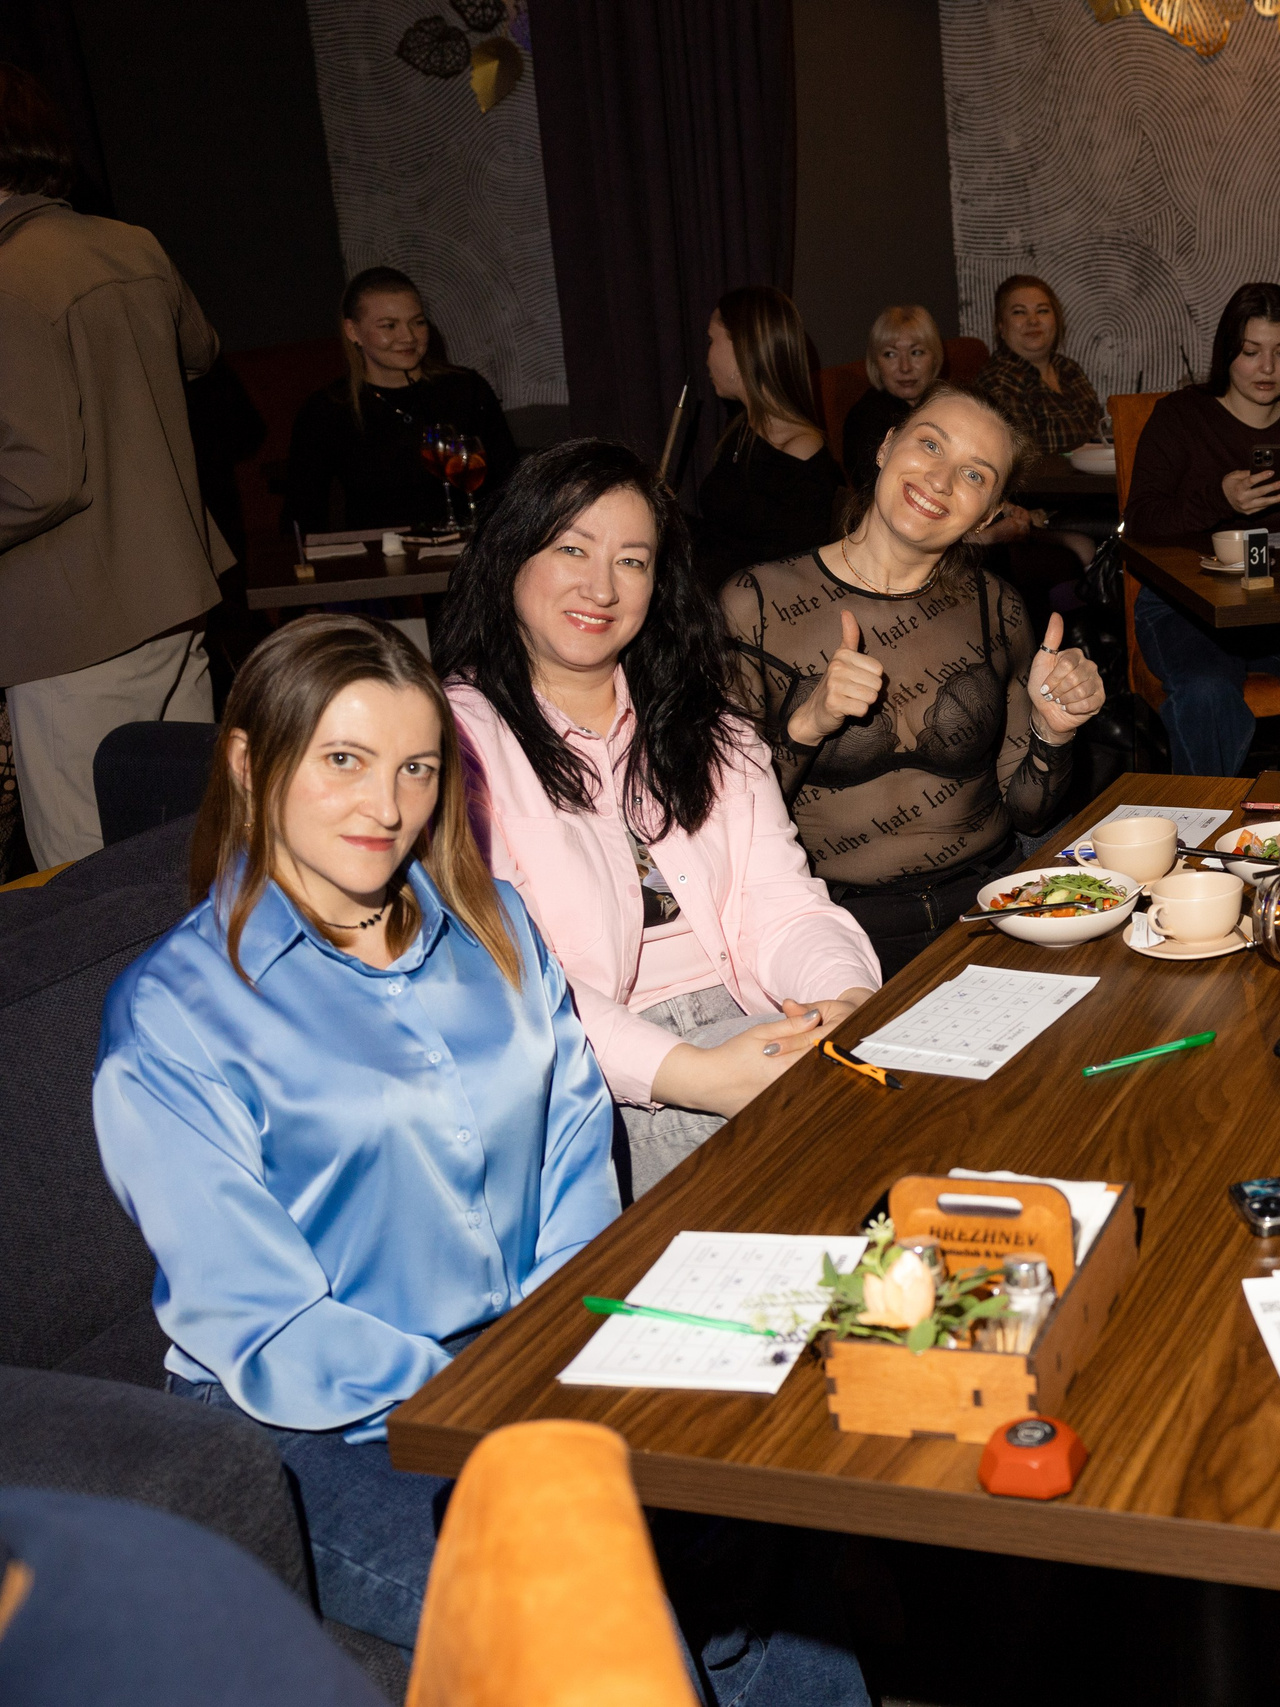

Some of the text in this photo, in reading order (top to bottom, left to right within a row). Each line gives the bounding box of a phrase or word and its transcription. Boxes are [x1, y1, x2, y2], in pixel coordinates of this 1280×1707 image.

[1250, 546, 1267, 565] 31
[771, 594, 821, 626] hate
[871, 614, 920, 650] hate
[923, 655, 971, 684] love
[823, 831, 871, 856] love
[871, 804, 923, 836] hate
[921, 777, 965, 809] love
[923, 834, 968, 868] love
